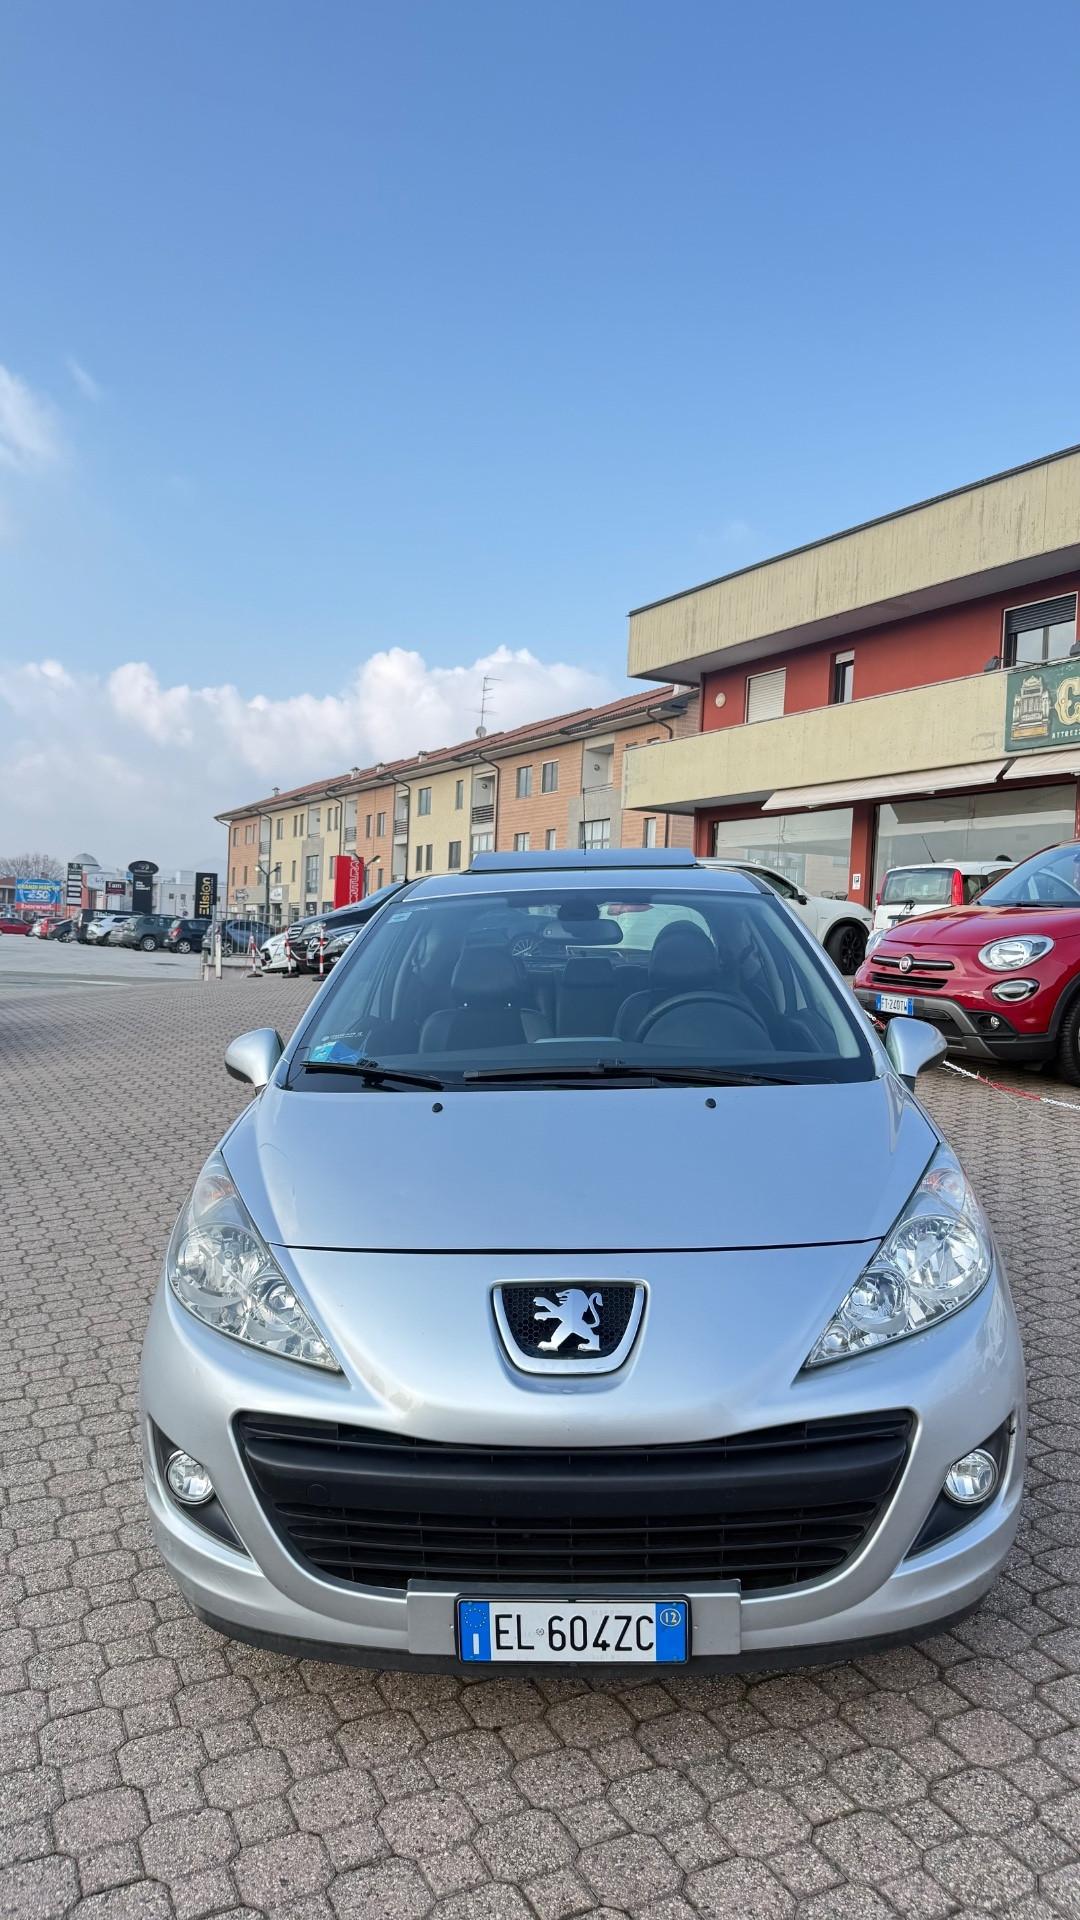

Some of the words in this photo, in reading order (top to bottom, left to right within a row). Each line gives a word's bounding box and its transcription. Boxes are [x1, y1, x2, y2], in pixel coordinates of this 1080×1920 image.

[199, 877, 210, 915] Elision
[664, 1611, 677, 1624] 12
[473, 1633, 480, 1655] I
[495, 1614, 535, 1650] EL
[548, 1615, 654, 1652] 604ZC
